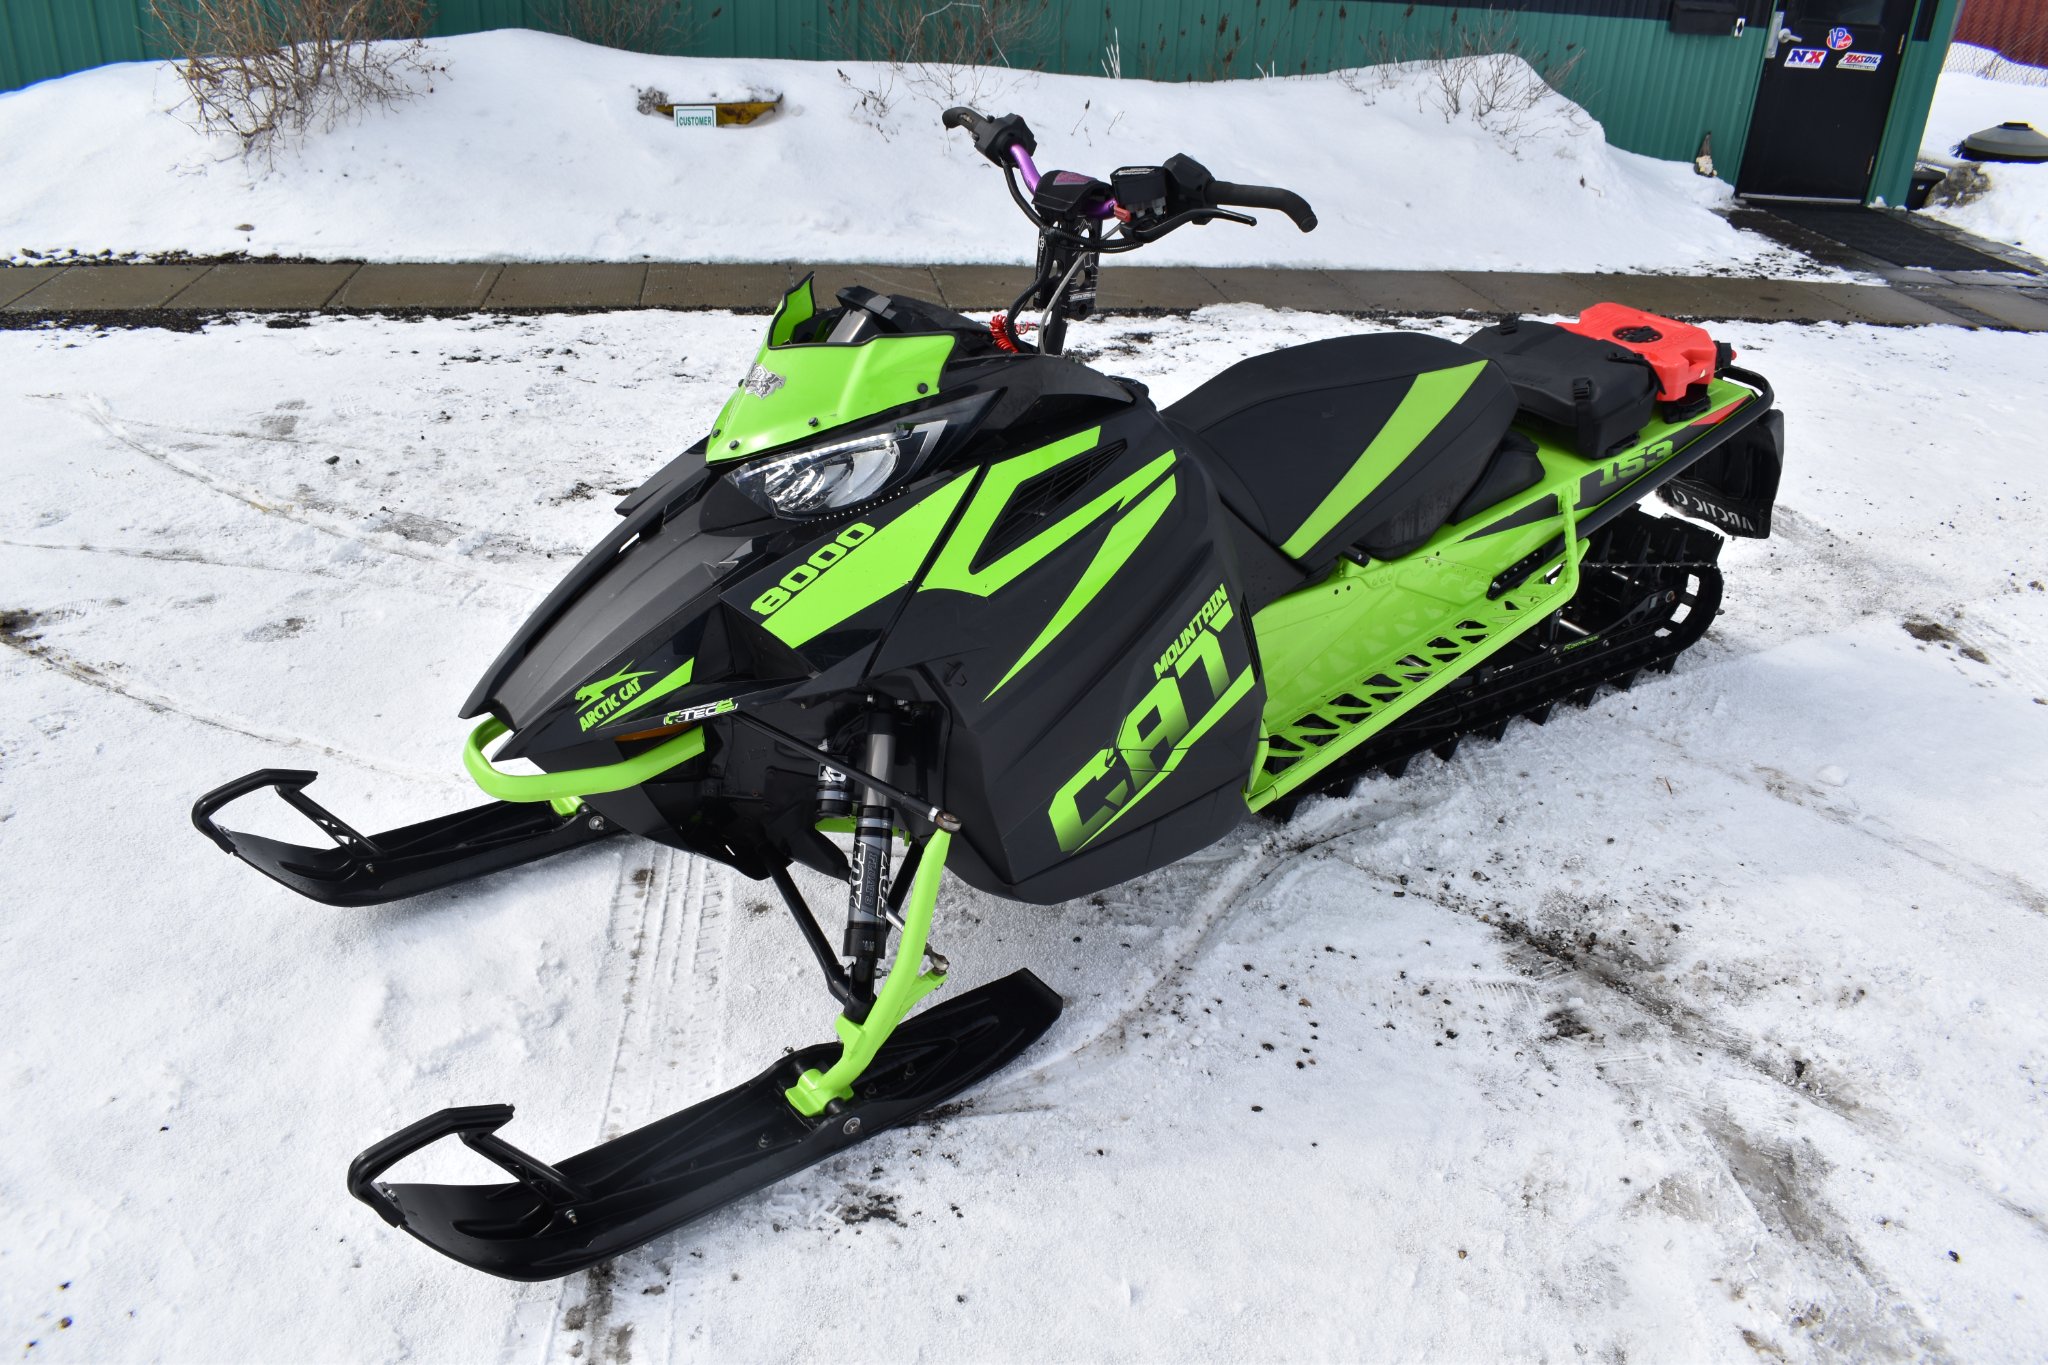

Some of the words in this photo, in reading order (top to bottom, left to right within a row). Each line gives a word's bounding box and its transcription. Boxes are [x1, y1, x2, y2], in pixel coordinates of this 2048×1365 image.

[1789, 50, 1825, 63] NX
[1829, 28, 1847, 48] VP
[1843, 54, 1879, 64] AMSOIL
[679, 116, 712, 126] CUSTOMER
[1600, 440, 1673, 487] 153
[751, 522, 875, 615] 8000
[1153, 583, 1228, 680] MOUNTAIN
[578, 692, 620, 733] ARCTIC
[619, 678, 642, 701] CAT
[1048, 601, 1234, 852] CAT
[866, 853, 877, 896] FLOAT
